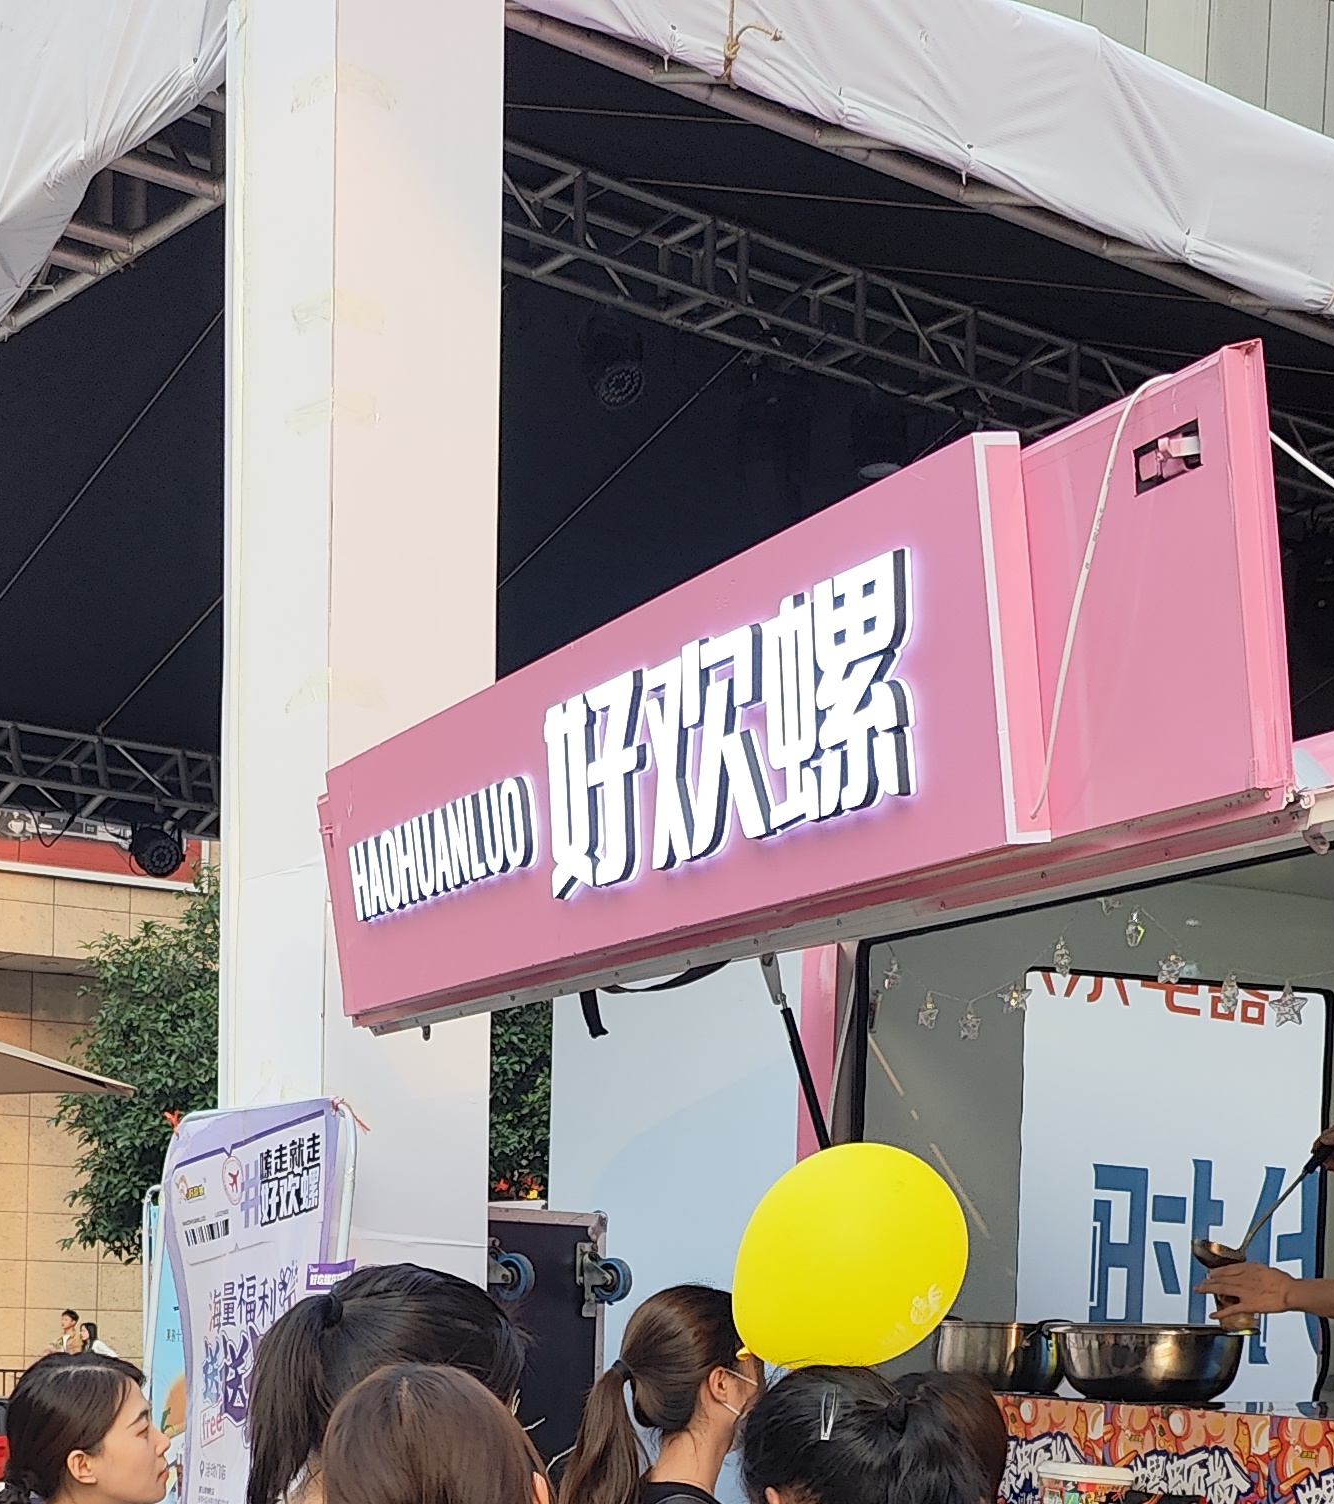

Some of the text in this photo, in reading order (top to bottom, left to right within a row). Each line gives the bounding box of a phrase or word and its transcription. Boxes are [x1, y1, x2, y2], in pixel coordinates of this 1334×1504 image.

[544, 546, 916, 899] 好欢螺
[348, 774, 538, 921] HAOHUANLUO
[261, 1163, 320, 1227] 好欢螺
